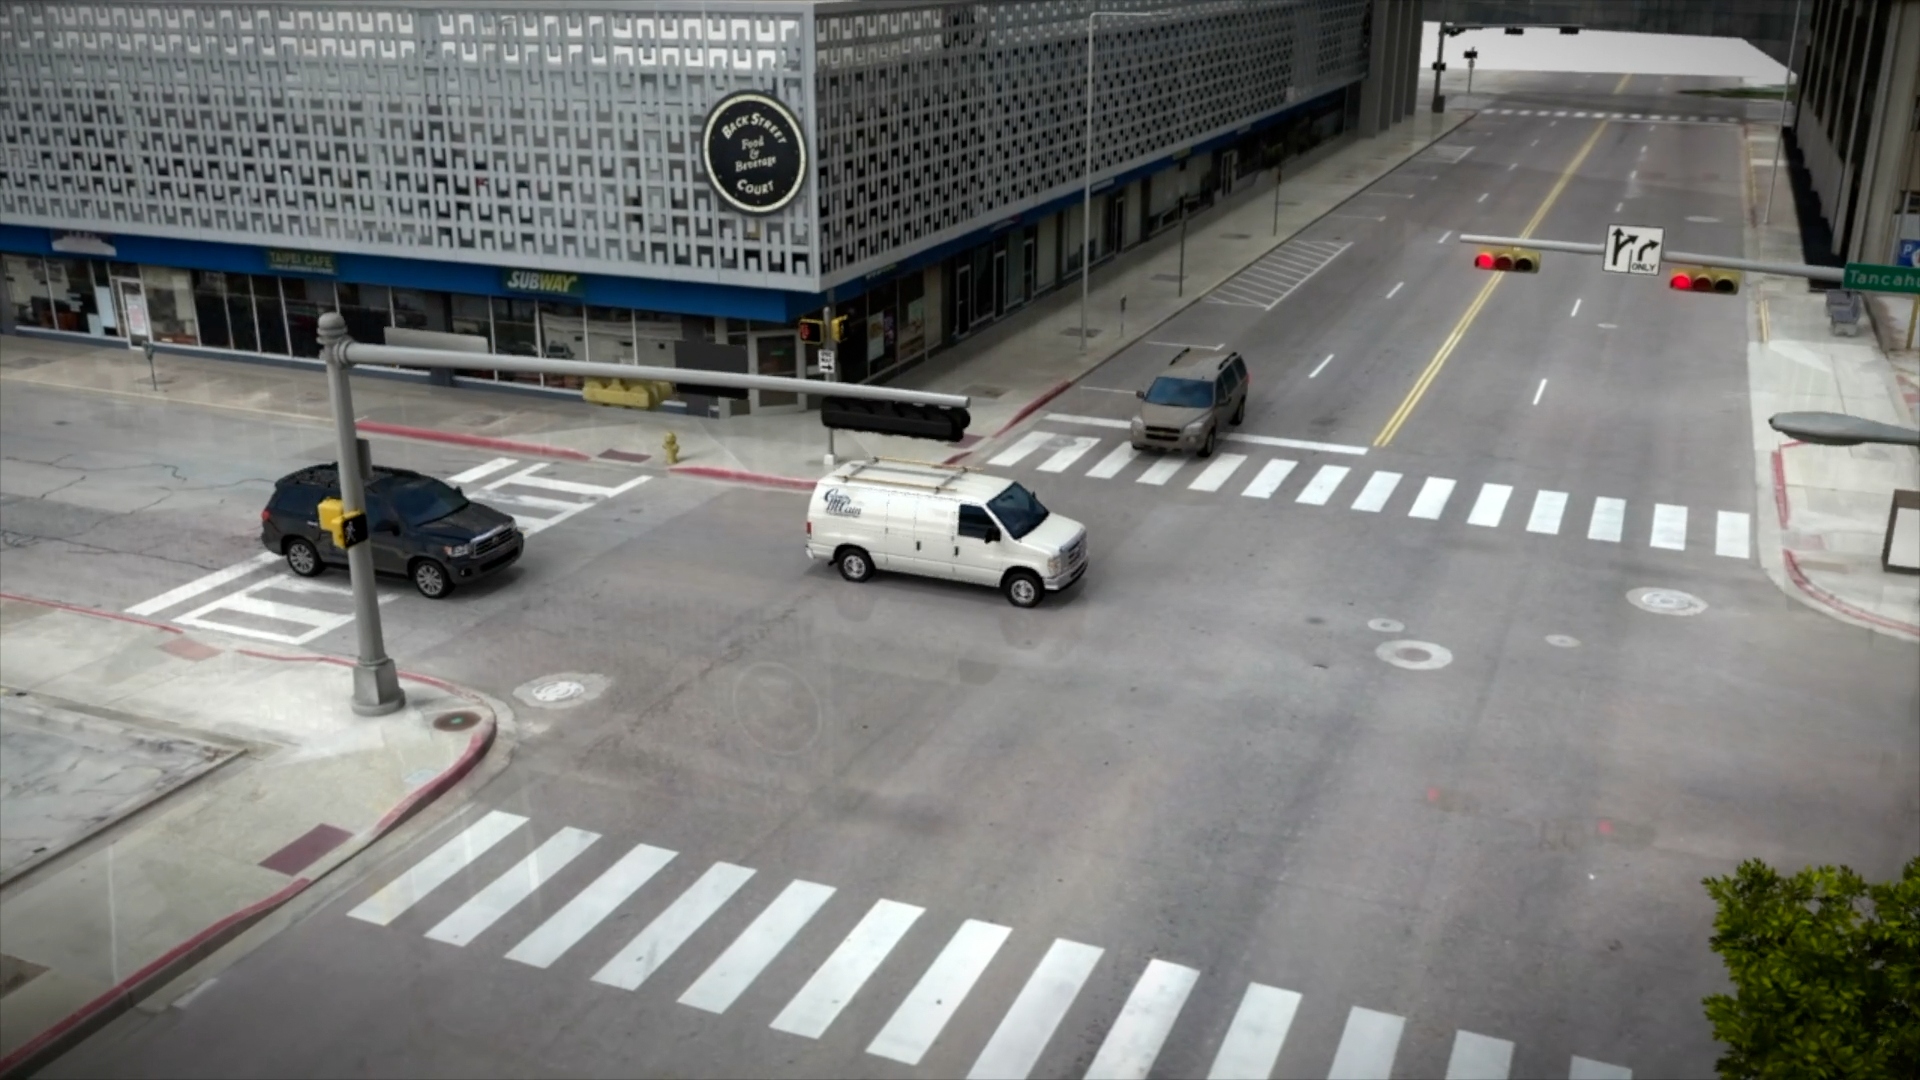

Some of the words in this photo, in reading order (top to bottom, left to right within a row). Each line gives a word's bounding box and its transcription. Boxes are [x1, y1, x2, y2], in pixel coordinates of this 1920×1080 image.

[721, 115, 750, 140] BACK
[750, 112, 788, 143] STREET
[741, 135, 765, 150] Food
[749, 148, 760, 159] &
[735, 156, 777, 172] Beverage
[737, 179, 774, 195] COURT
[1631, 262, 1657, 272] ONLY
[507, 270, 578, 293] SUBWAY
